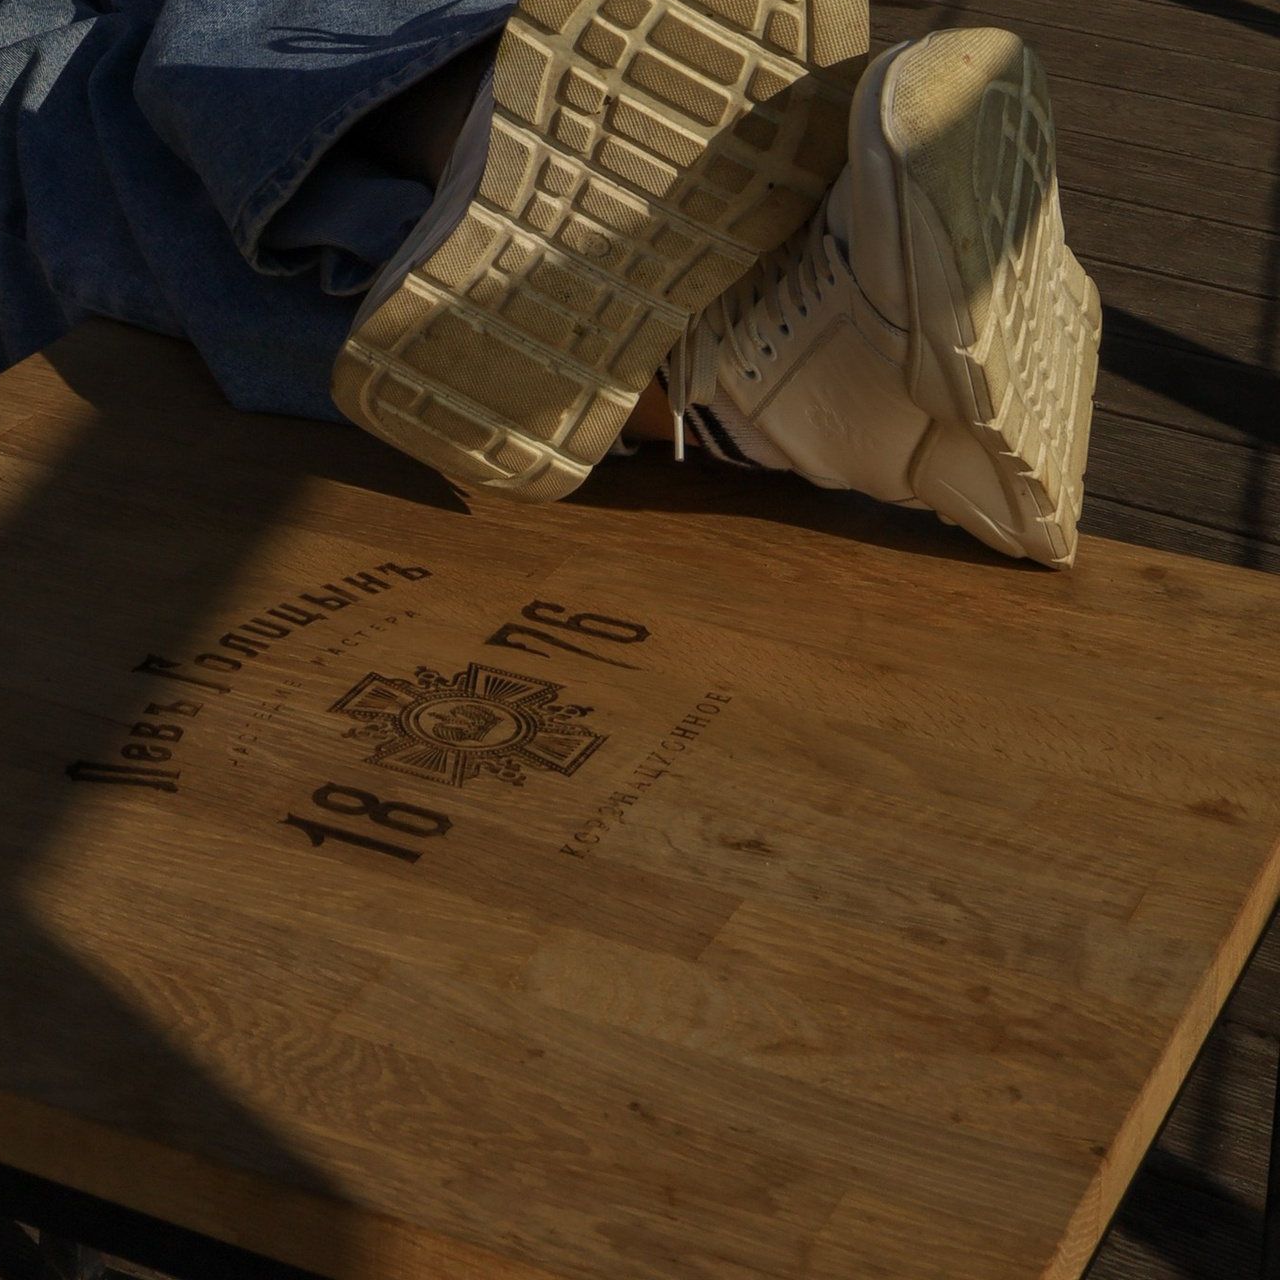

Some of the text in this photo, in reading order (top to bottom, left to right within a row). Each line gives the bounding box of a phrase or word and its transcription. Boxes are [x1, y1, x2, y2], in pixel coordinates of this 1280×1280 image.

[65, 562, 434, 793] Левъ Голицынъ
[276, 599, 651, 864] 18 76
